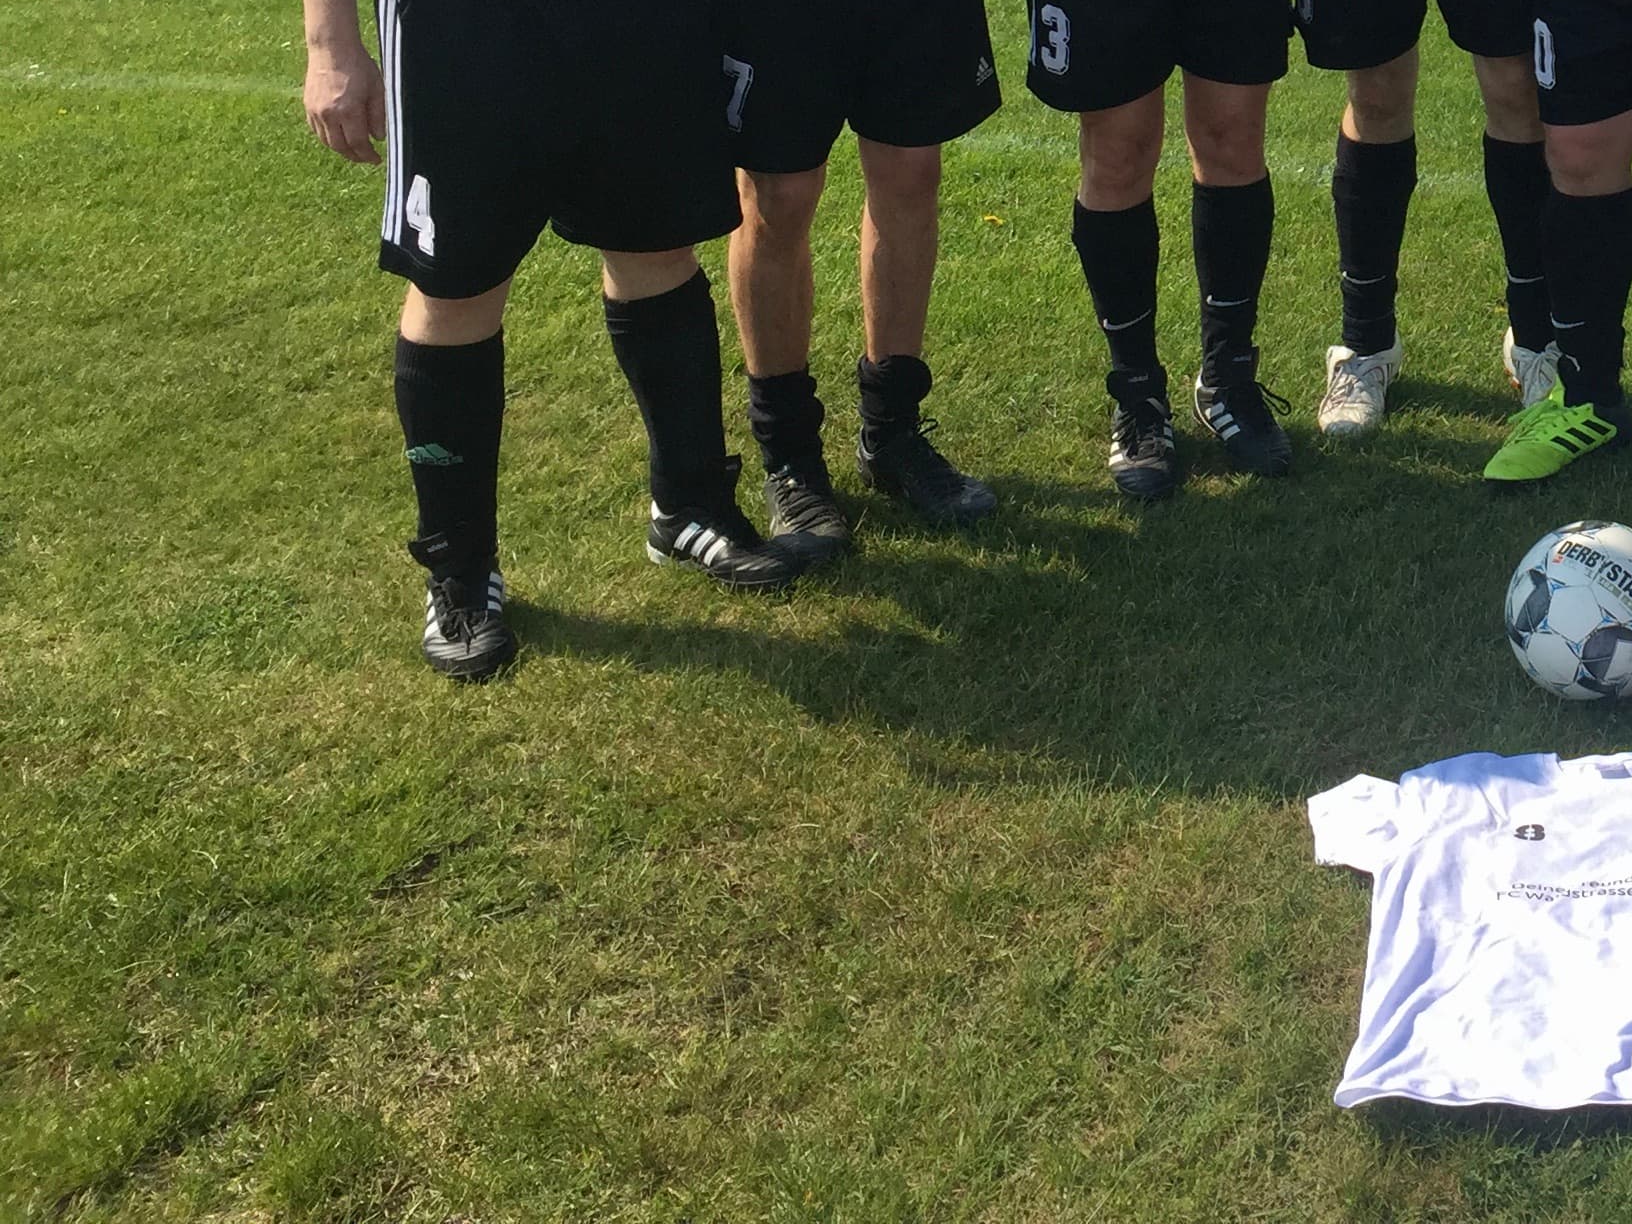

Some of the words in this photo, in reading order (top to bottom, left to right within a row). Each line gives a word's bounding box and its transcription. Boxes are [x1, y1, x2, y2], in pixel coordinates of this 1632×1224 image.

[1041, 4, 1070, 75] 3
[723, 54, 754, 133] 7
[406, 174, 435, 256] 4
